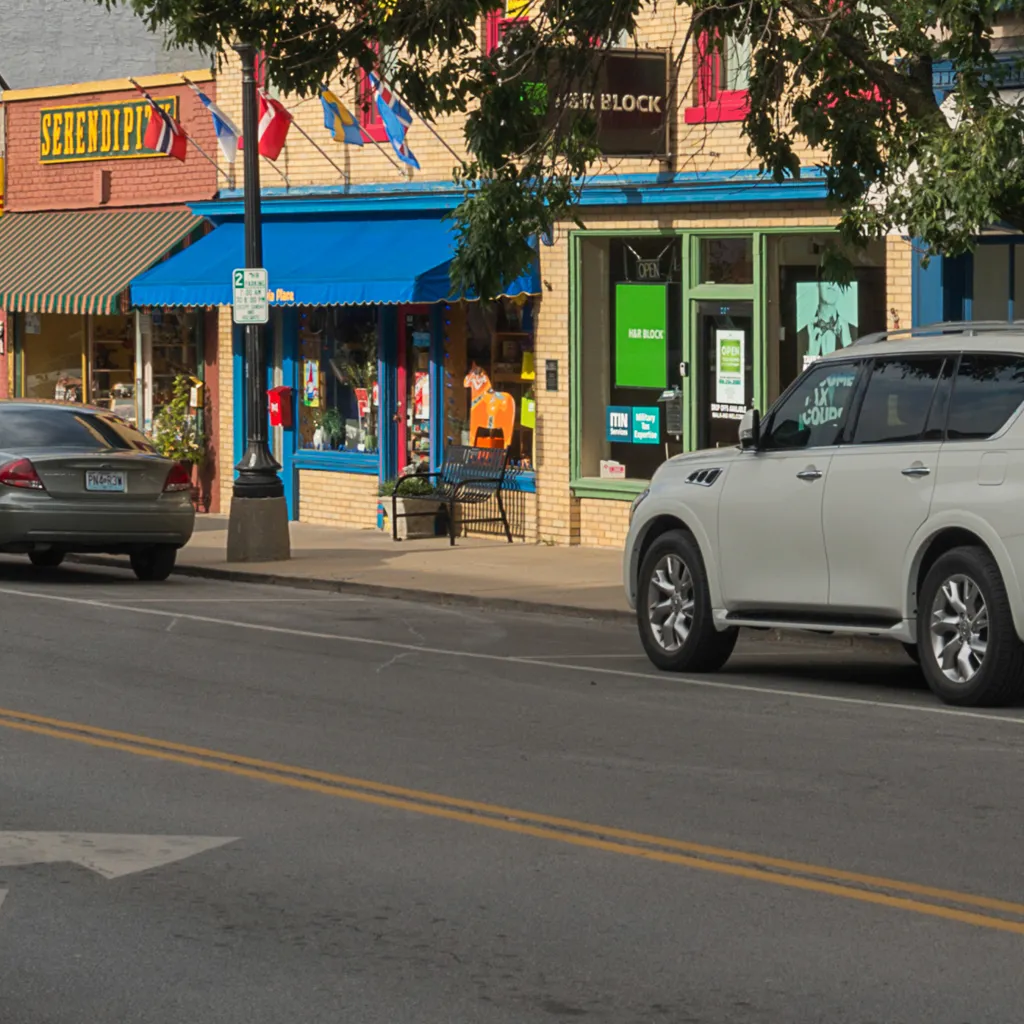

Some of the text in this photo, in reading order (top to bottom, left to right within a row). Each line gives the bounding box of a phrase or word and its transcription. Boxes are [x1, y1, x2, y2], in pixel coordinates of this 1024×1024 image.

[600, 93, 661, 113] BLOCK
[638, 262, 661, 278] OPEN
[235, 272, 243, 287] 2
[276, 288, 294, 301] Place
[628, 328, 664, 340] H&R BLOCK
[721, 346, 740, 356] OPEN
[609, 412, 629, 428] ITIN
[635, 413, 656, 424] Military
[609, 428, 629, 436] Services
[641, 422, 650, 430] Tax
[634, 430, 658, 440] Expertise
